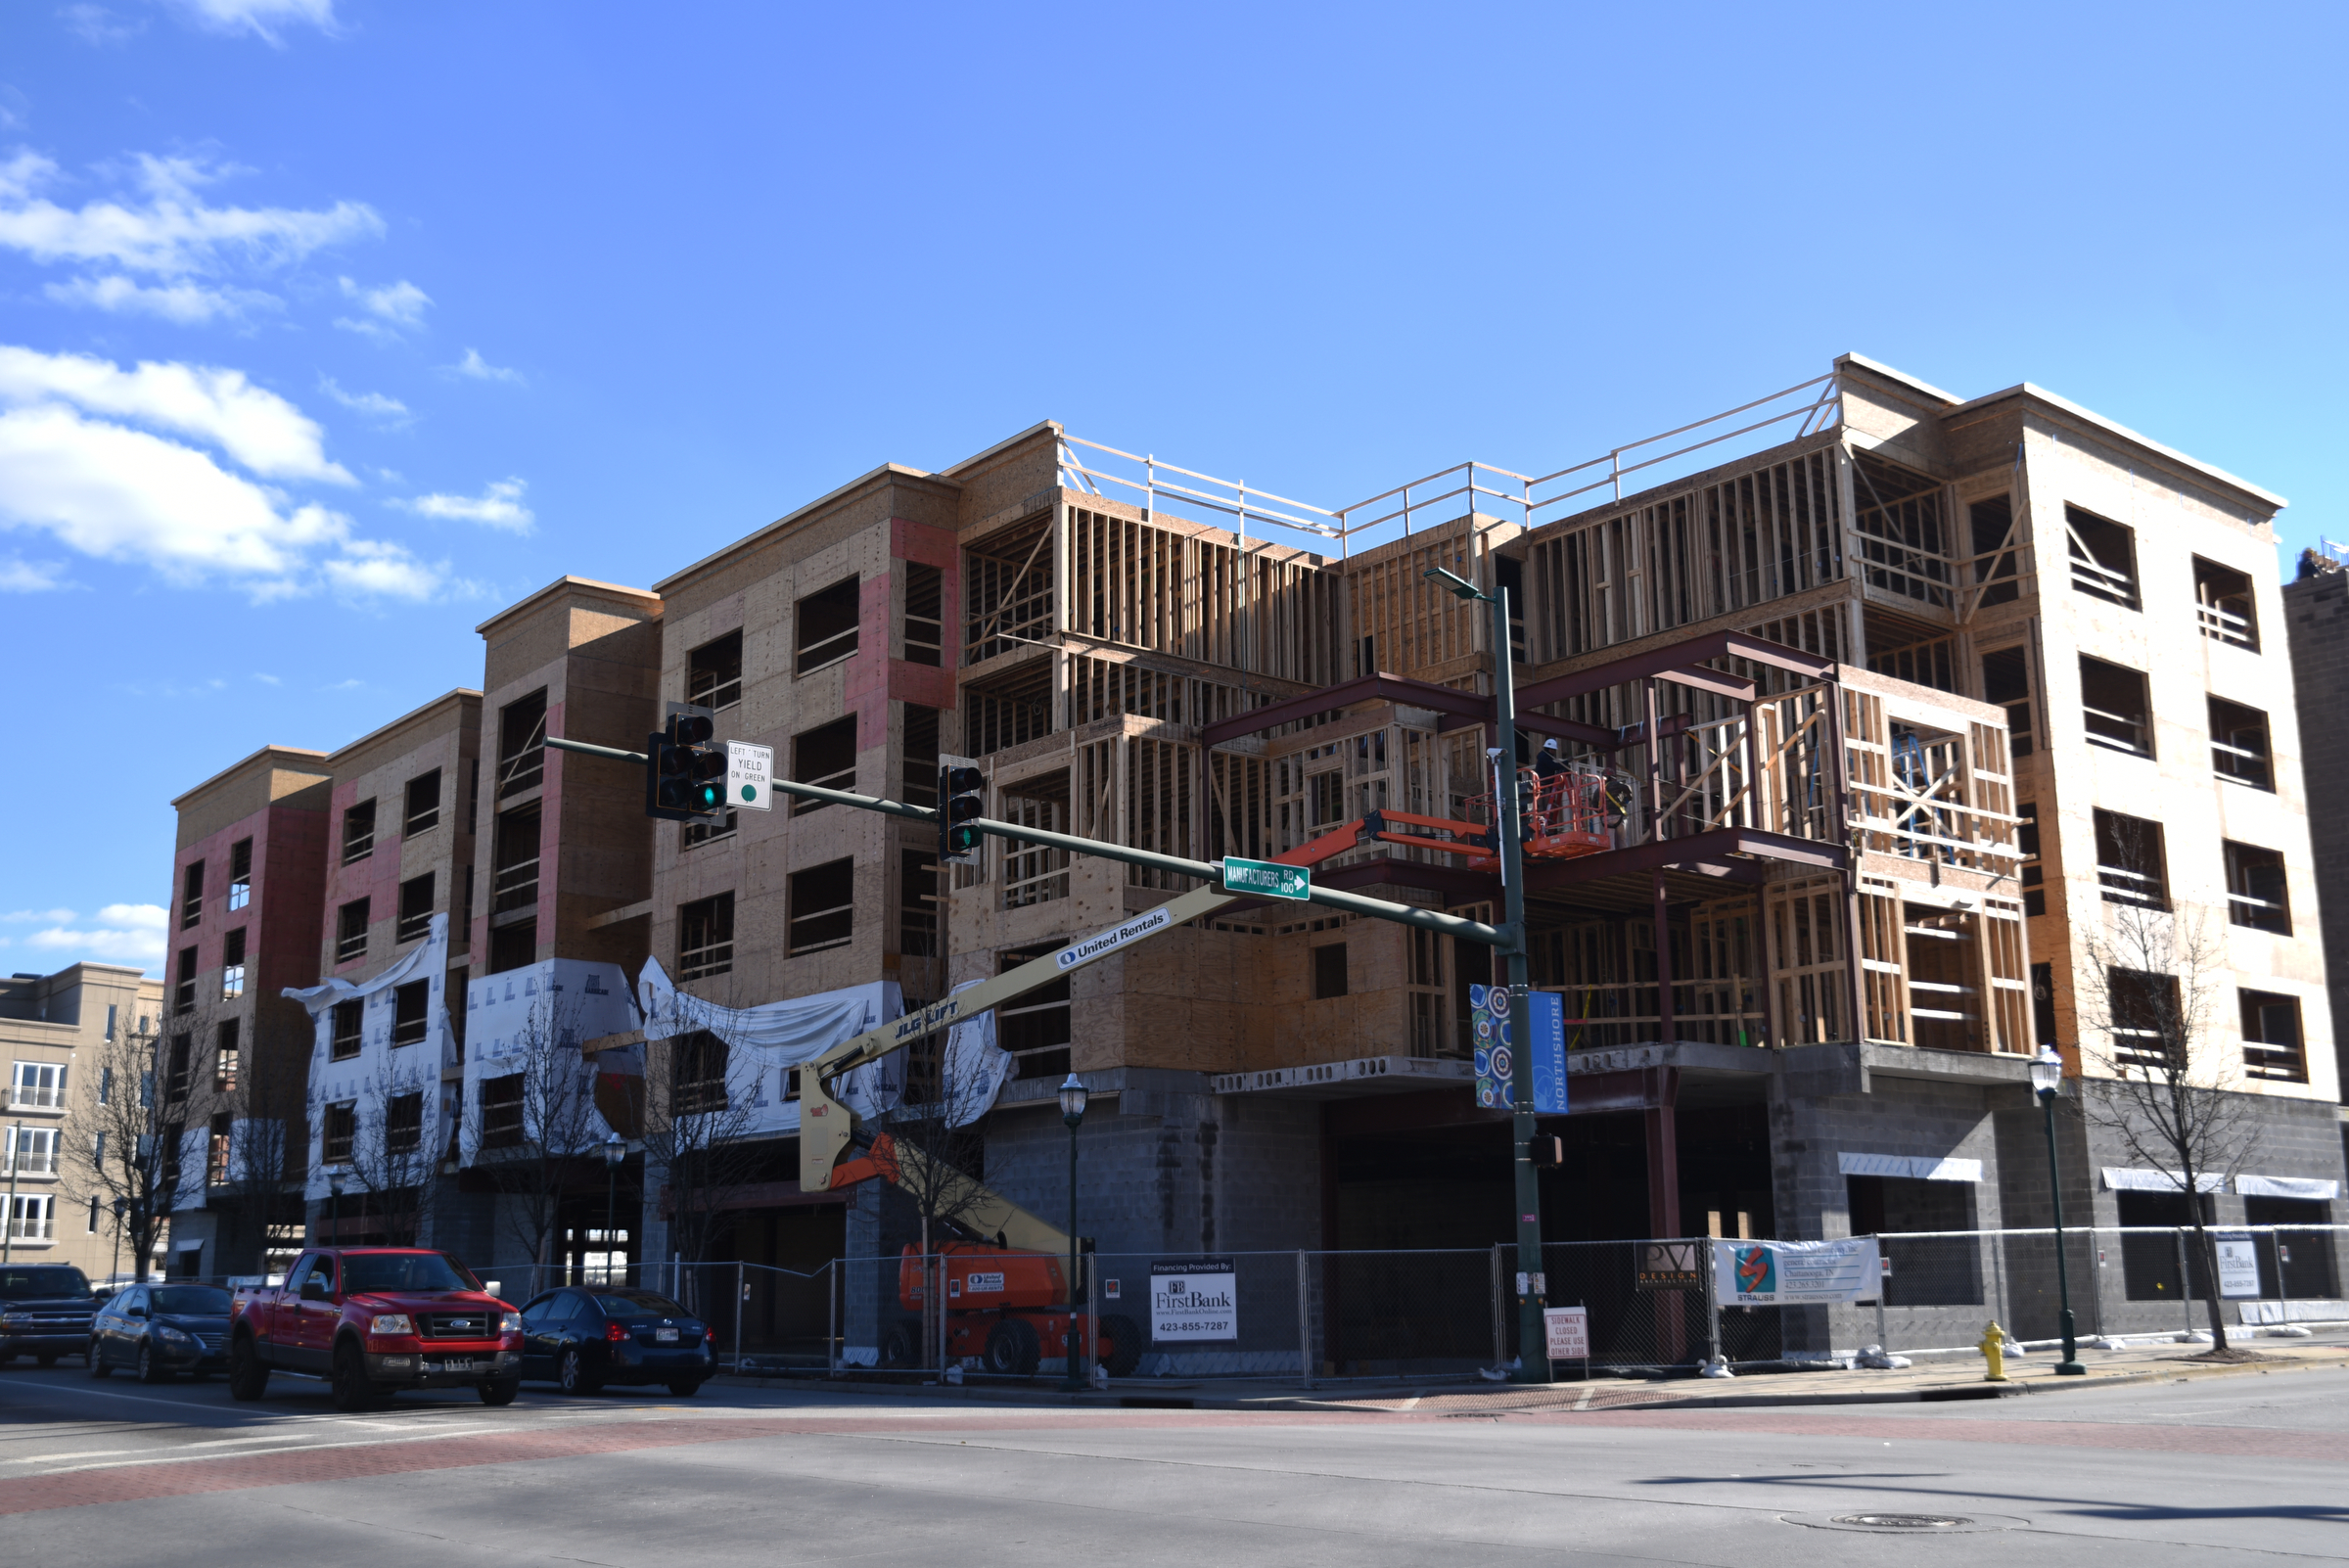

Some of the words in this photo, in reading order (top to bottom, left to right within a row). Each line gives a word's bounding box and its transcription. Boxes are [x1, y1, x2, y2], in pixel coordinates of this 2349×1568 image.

[730, 747, 746, 756] LEFT
[753, 750, 770, 760] TURN
[737, 759, 762, 771] YIELD
[731, 770, 740, 779] ON
[745, 772, 766, 782] GREEN
[1226, 865, 1279, 889] MANUFACTURERS
[1283, 869, 1294, 881] RD
[1280, 882, 1294, 894] 100
[1078, 932, 1118, 958] United
[1120, 914, 1164, 940] Rentals
[895, 1016, 921, 1039] JLG
[926, 1000, 957, 1025] LIFT
[1550, 996, 1565, 1110] NORTHSHORE
[1644, 1244, 1690, 1270] PV
[2220, 1256, 2254, 1268] FirstBank
[1221, 1262, 1232, 1270] By:
[1156, 1291, 1231, 1309] FirstBank
[1551, 1315, 1581, 1324] SIDEWALK
[1159, 1321, 1228, 1331] 423-855-7287
[1555, 1326, 1578, 1335] CLOSED
[1549, 1337, 1571, 1346] PLEASE
[1573, 1336, 1585, 1345] USE
[1551, 1347, 1570, 1356] OTHER
[1571, 1346, 1585, 1355] SIDE
